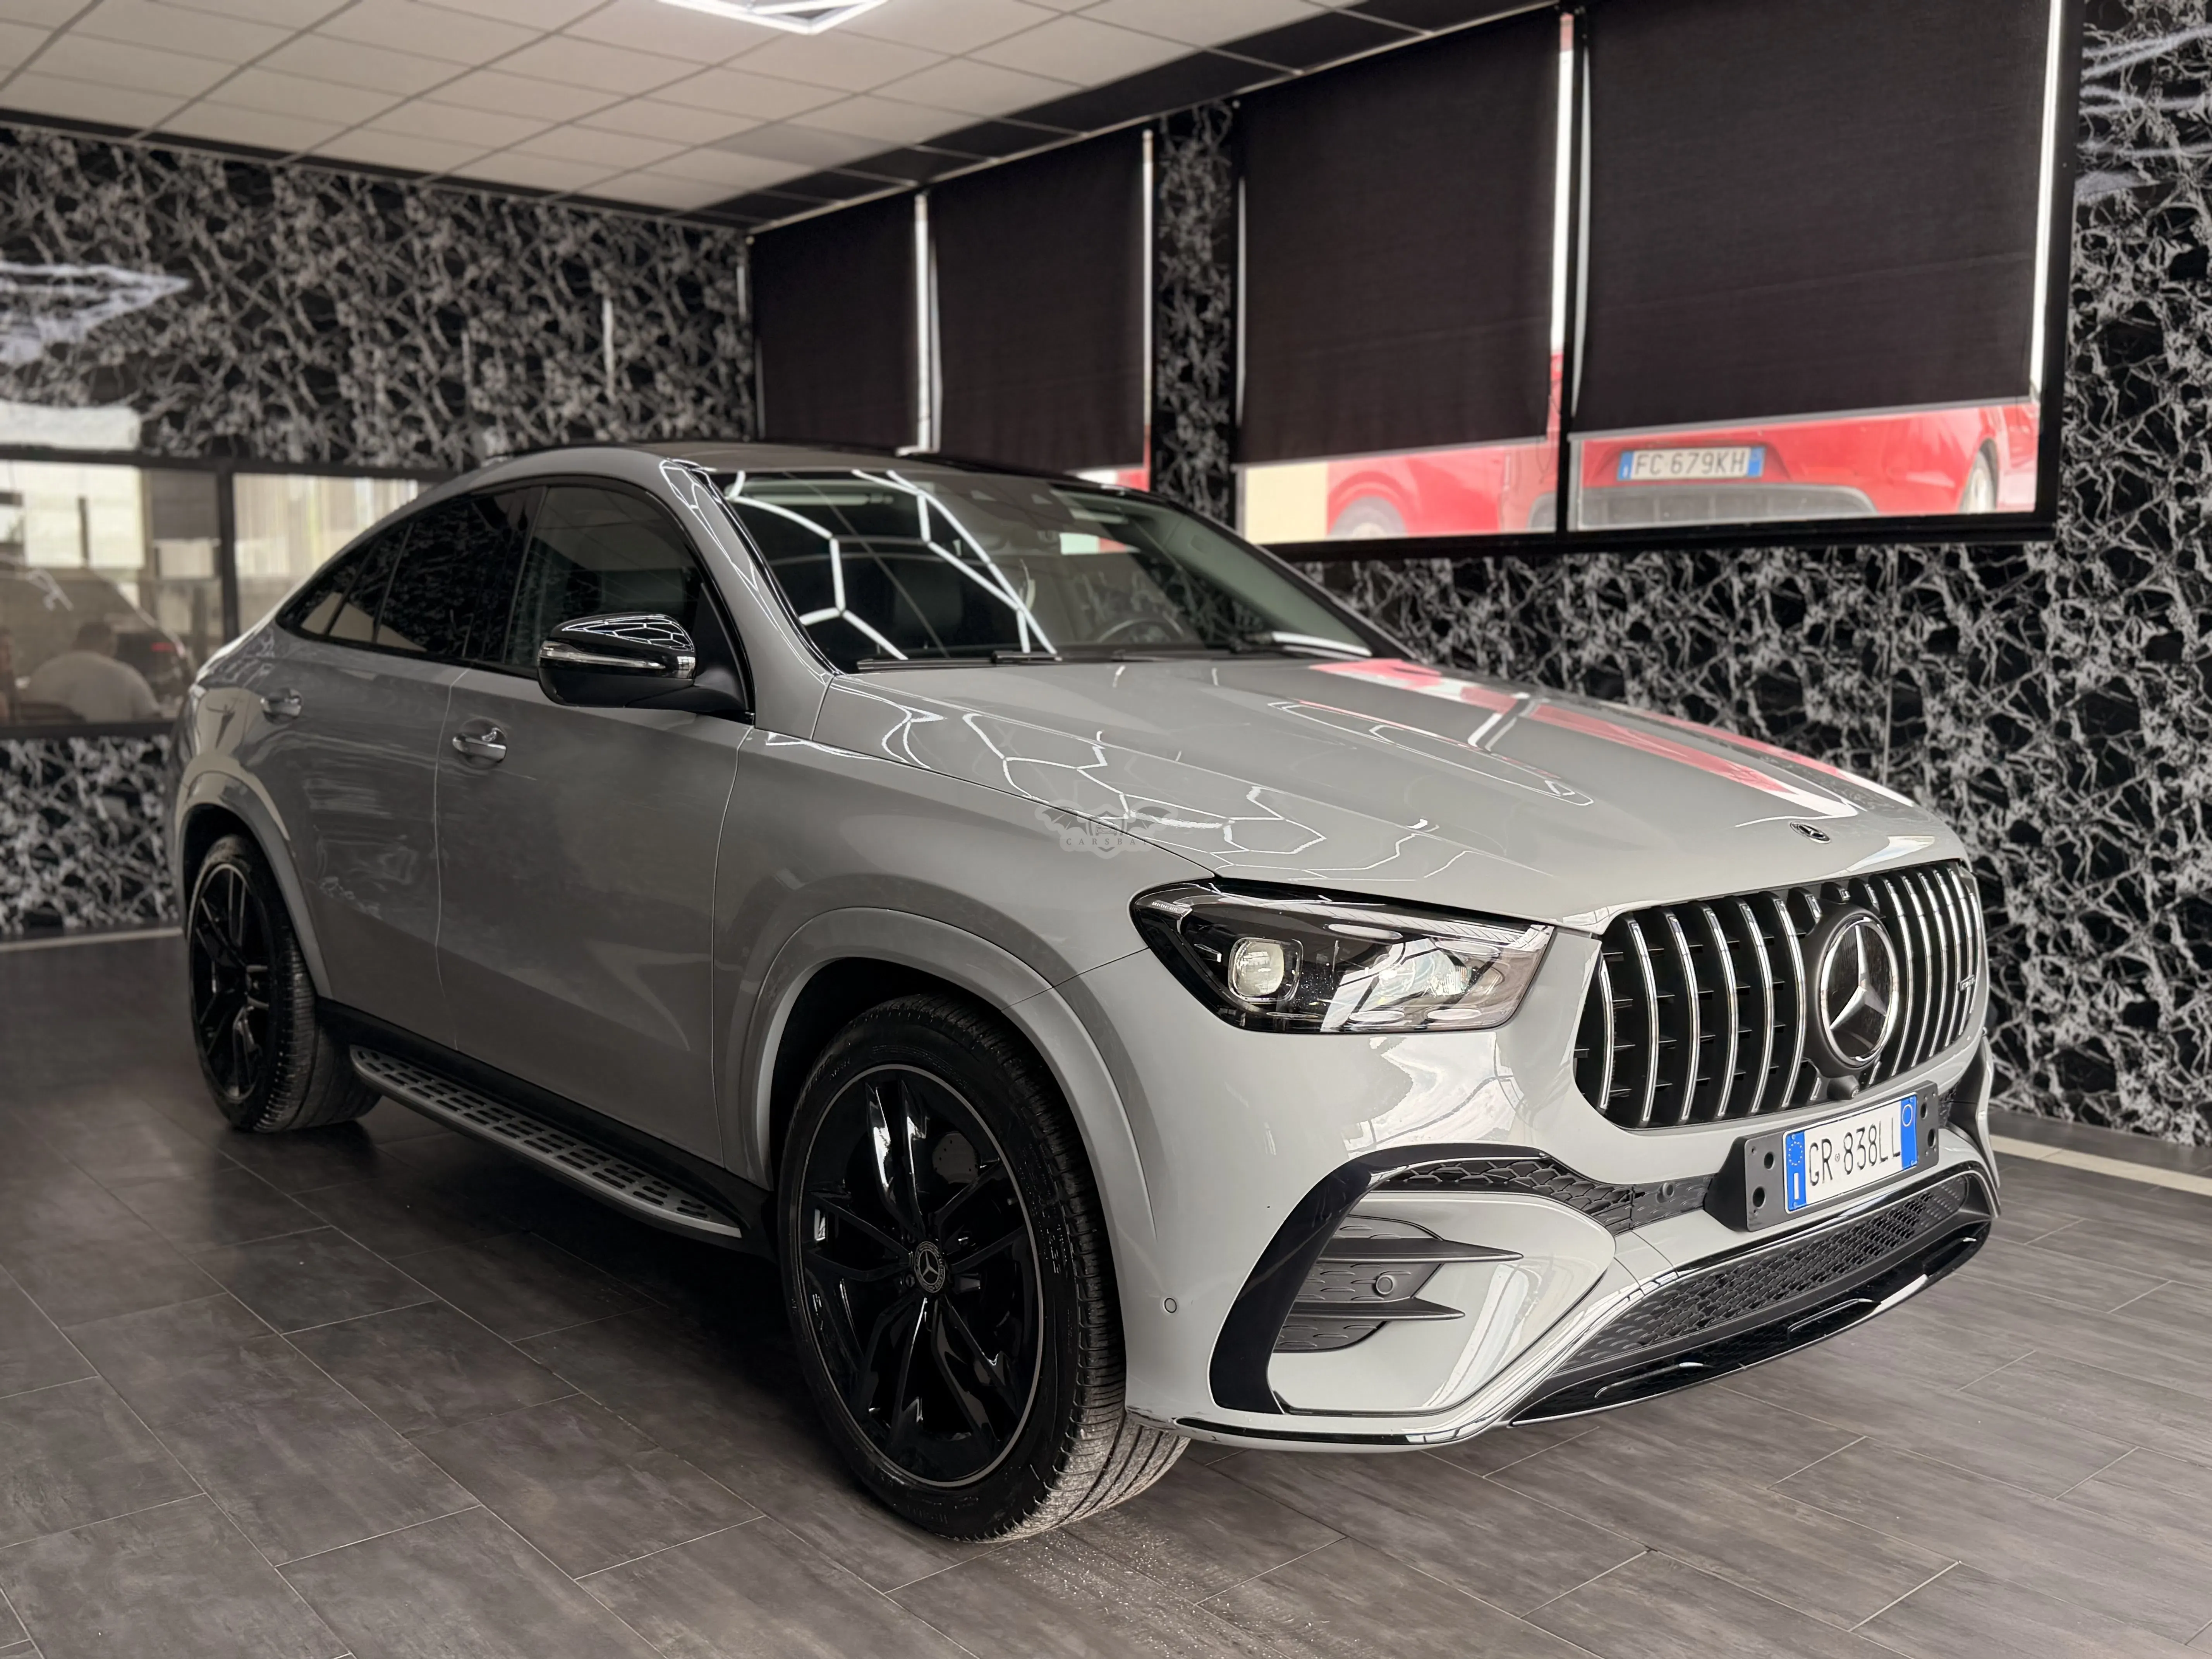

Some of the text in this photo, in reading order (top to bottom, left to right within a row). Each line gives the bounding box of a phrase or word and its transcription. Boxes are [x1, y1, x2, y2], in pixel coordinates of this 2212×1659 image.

[1634, 454, 1664, 475] FC
[1670, 451, 1745, 475] 679KH
[1809, 1137, 1833, 1187] GR
[1843, 1117, 1901, 1175] 838LL
